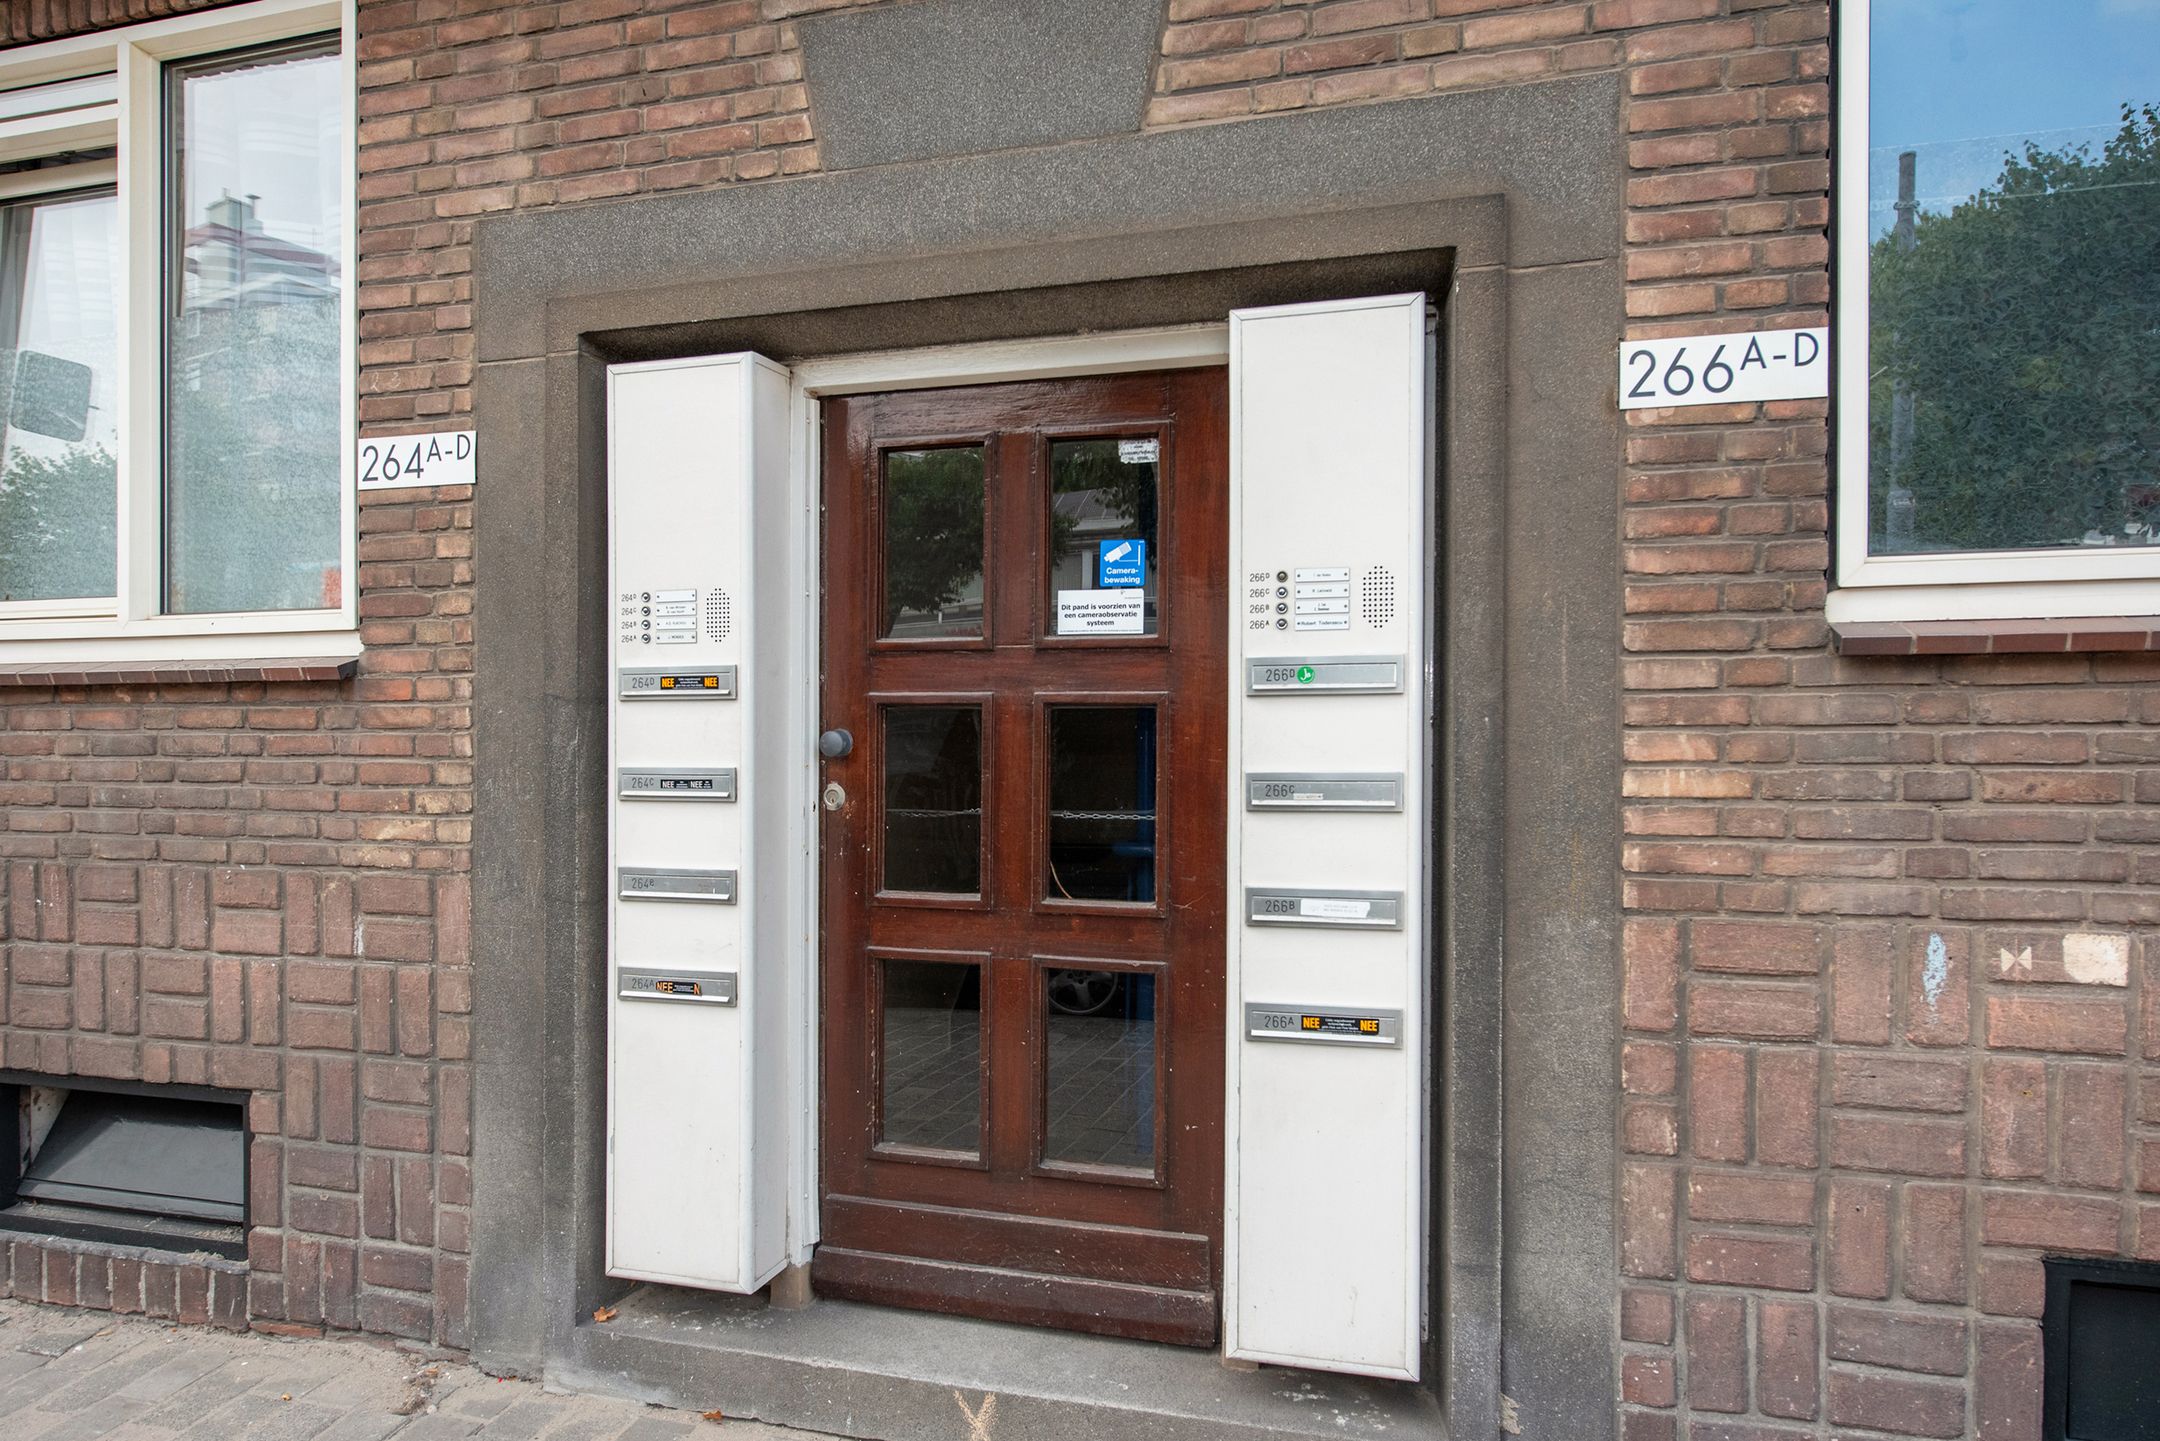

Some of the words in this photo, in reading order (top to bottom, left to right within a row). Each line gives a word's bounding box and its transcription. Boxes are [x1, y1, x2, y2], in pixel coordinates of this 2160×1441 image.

[1628, 332, 1819, 398] 266A-D
[362, 434, 471, 482] 264A-D
[1249, 572, 1270, 582] 266D
[1249, 588, 1270, 598] 266C
[1061, 603, 1071, 611] Dit
[1249, 604, 1270, 614] 266B
[1249, 620, 1270, 630] 266A
[1265, 668, 1296, 682] 266D
[661, 677, 675, 688] NEE
[704, 677, 718, 687] NEE
[662, 781, 675, 789] NEE
[690, 781, 703, 789] NEE
[1264, 784, 1295, 797] 266C
[1264, 900, 1296, 913] 266B
[656, 981, 673, 994] NEE
[1264, 1015, 1295, 1029] 266A
[1303, 1017, 1320, 1029] NEE
[1360, 1020, 1378, 1032] NEE
